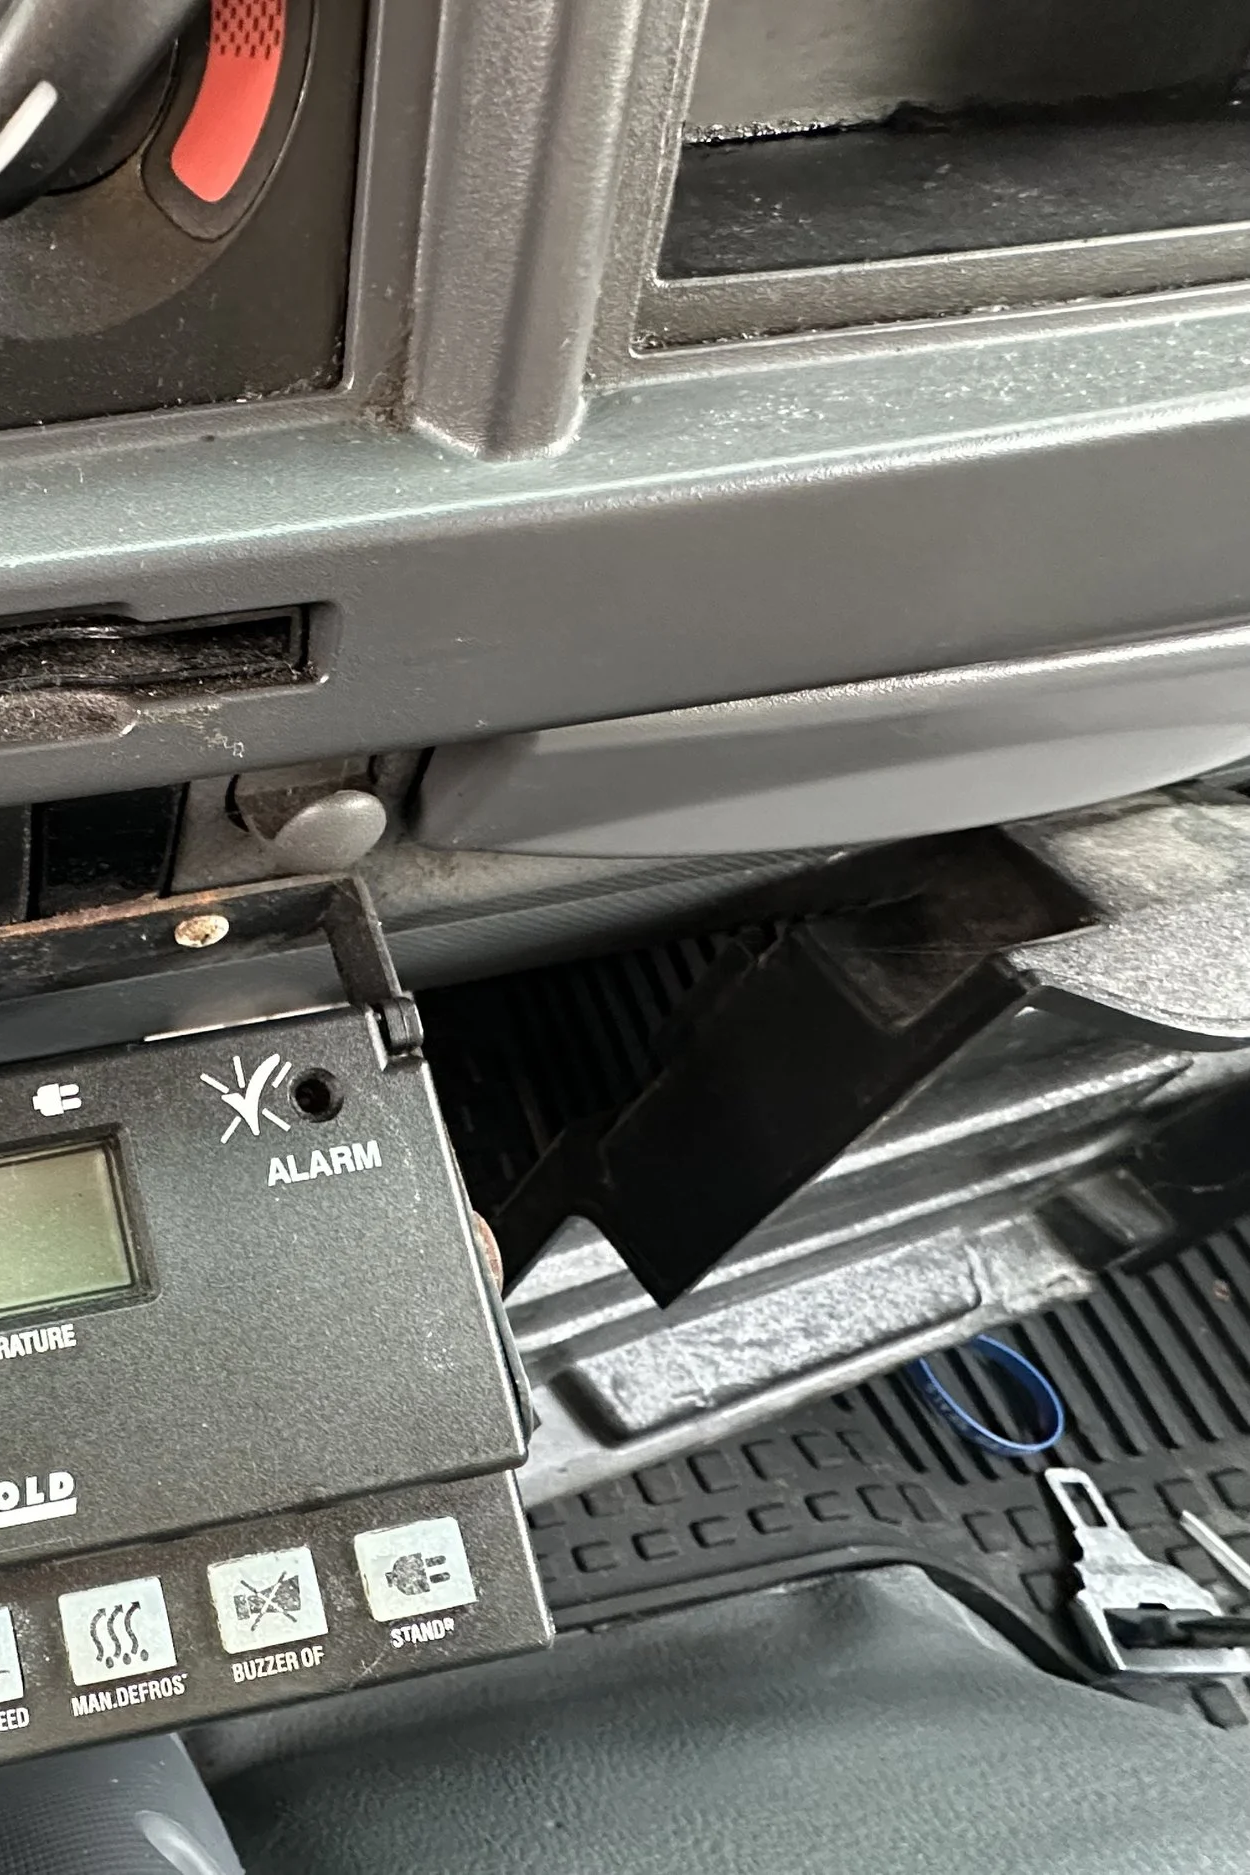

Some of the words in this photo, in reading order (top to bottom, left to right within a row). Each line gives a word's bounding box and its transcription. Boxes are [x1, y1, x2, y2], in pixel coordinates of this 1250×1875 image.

[267, 1140, 382, 1187] ALARM
[232, 1652, 299, 1682] BUZZER
[71, 1673, 188, 1717] MAN.DEFROS
